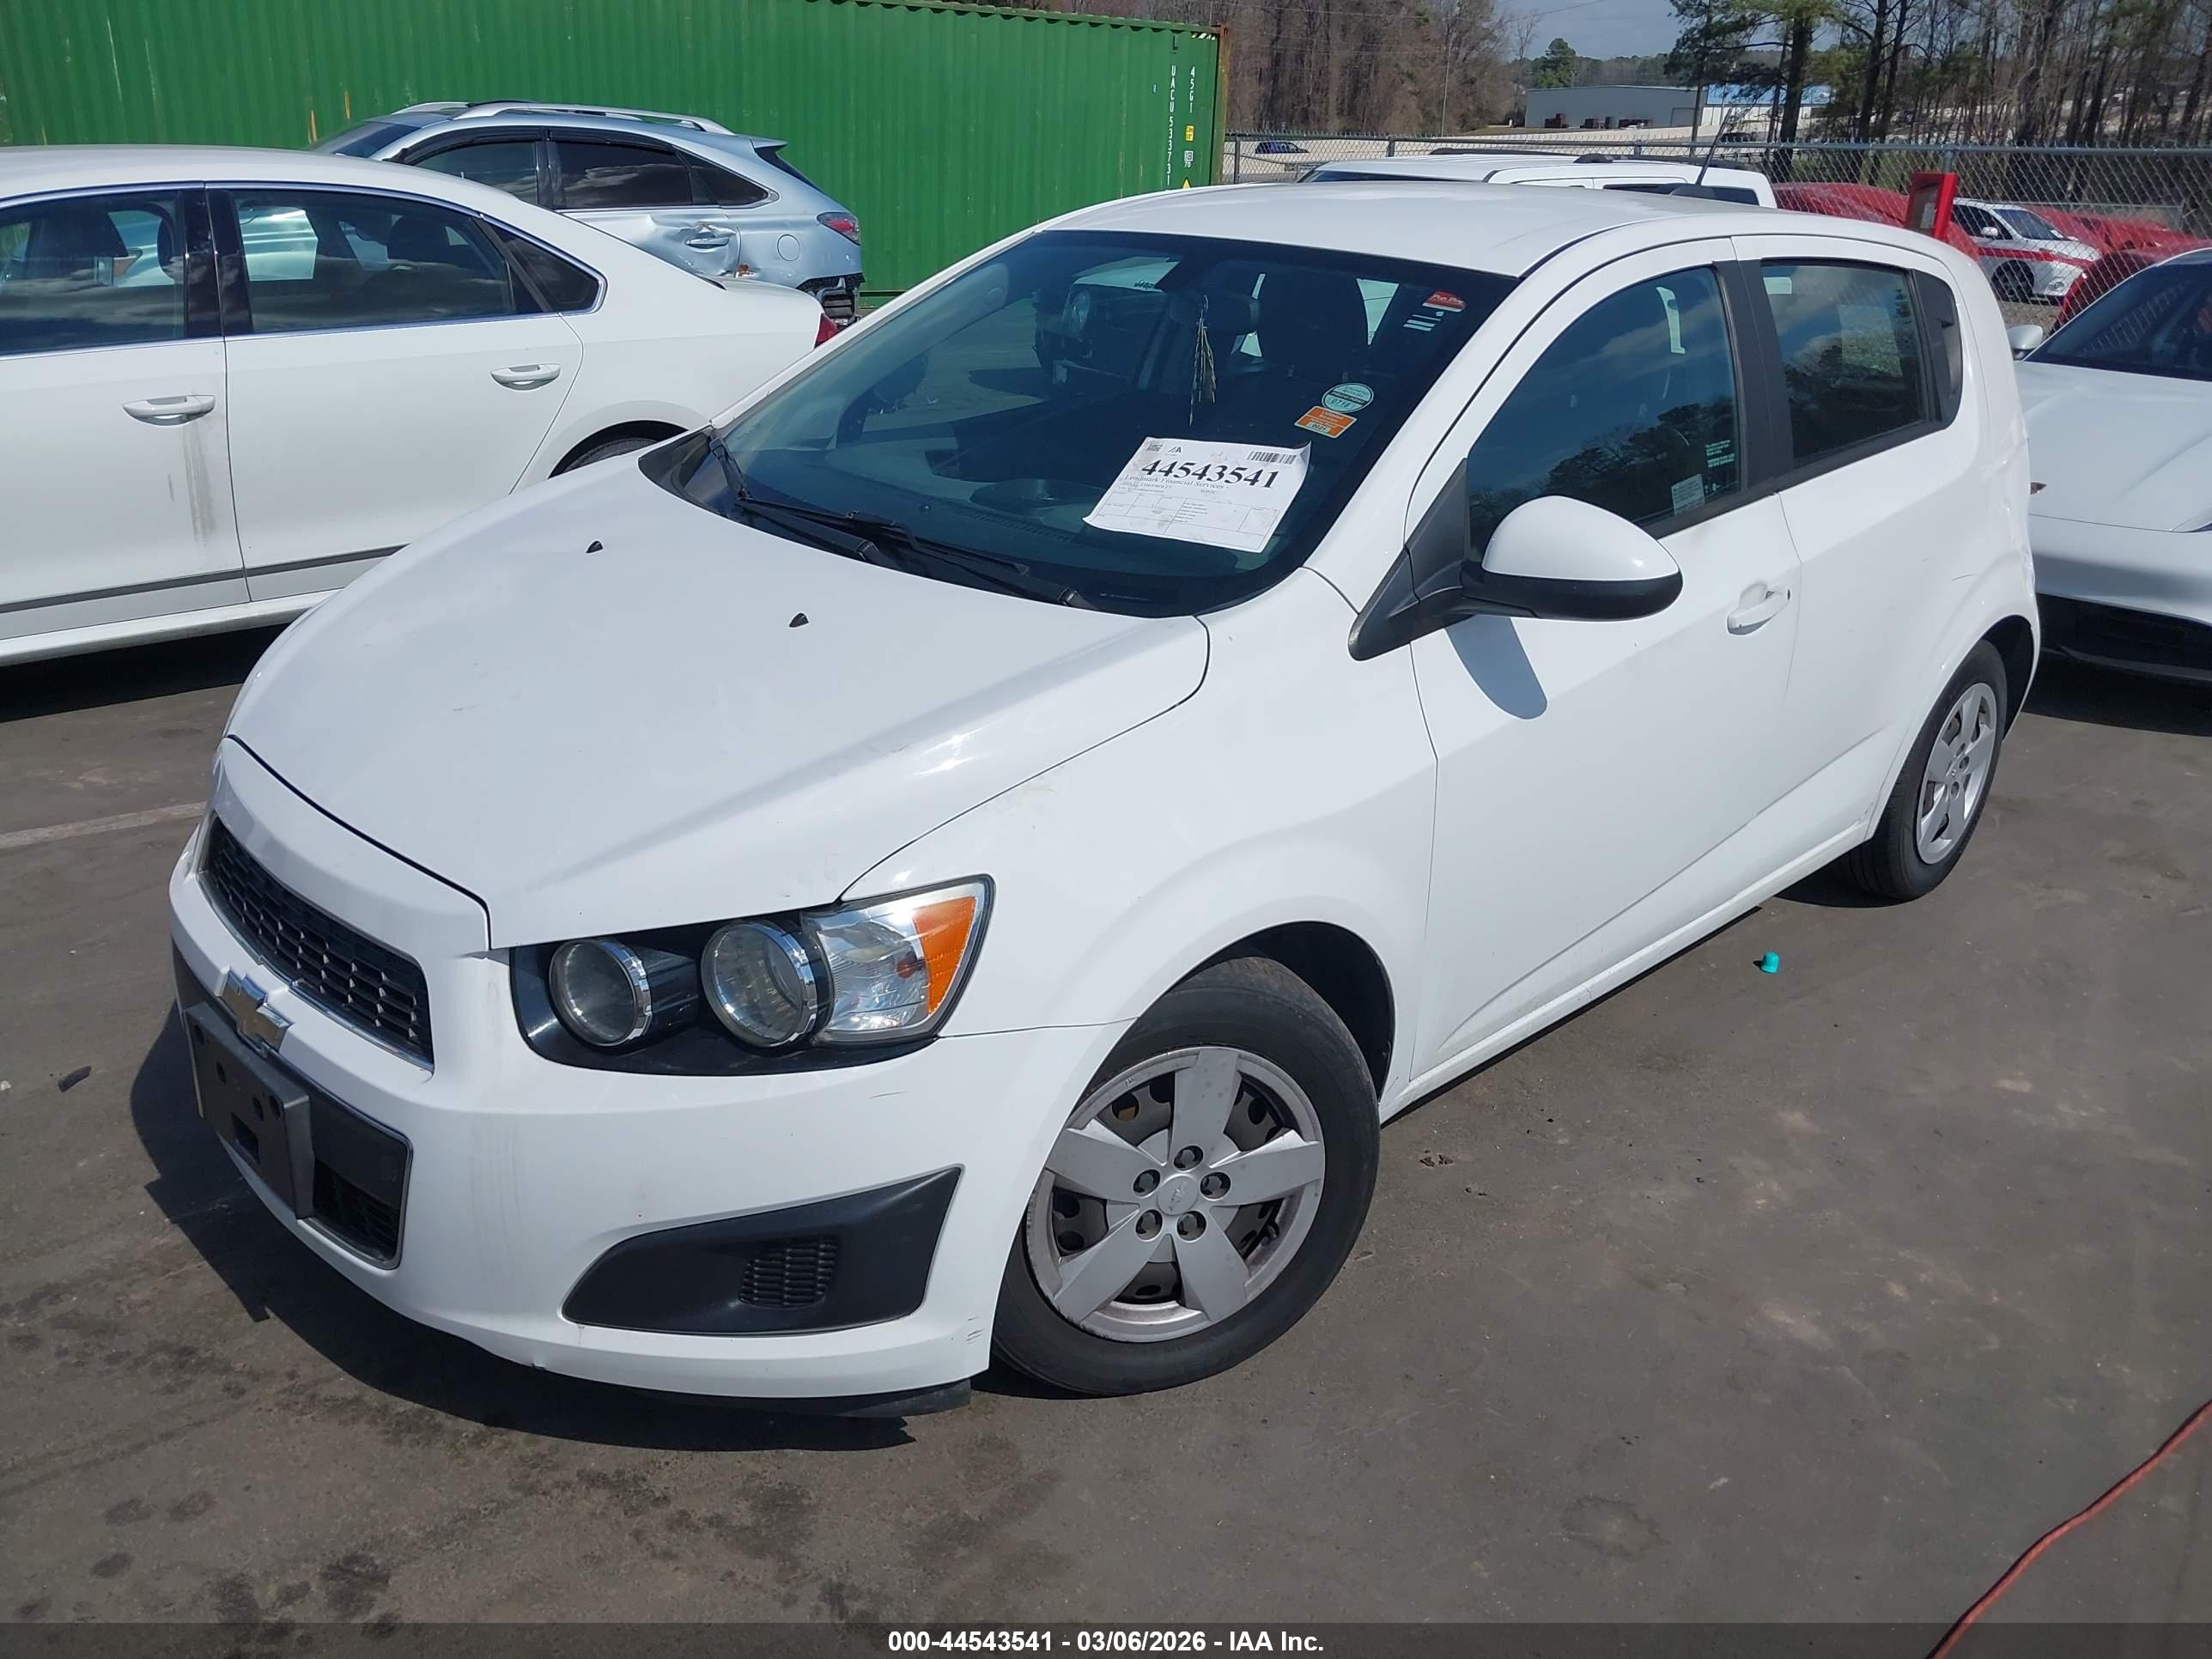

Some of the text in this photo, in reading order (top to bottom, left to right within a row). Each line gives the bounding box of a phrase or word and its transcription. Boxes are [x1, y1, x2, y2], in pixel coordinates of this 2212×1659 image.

[1125, 473, 1158, 483] Lendmark
[1160, 477, 1194, 487] Financial
[1194, 481, 1224, 489] Services
[1141, 459, 1279, 489] 44543541
